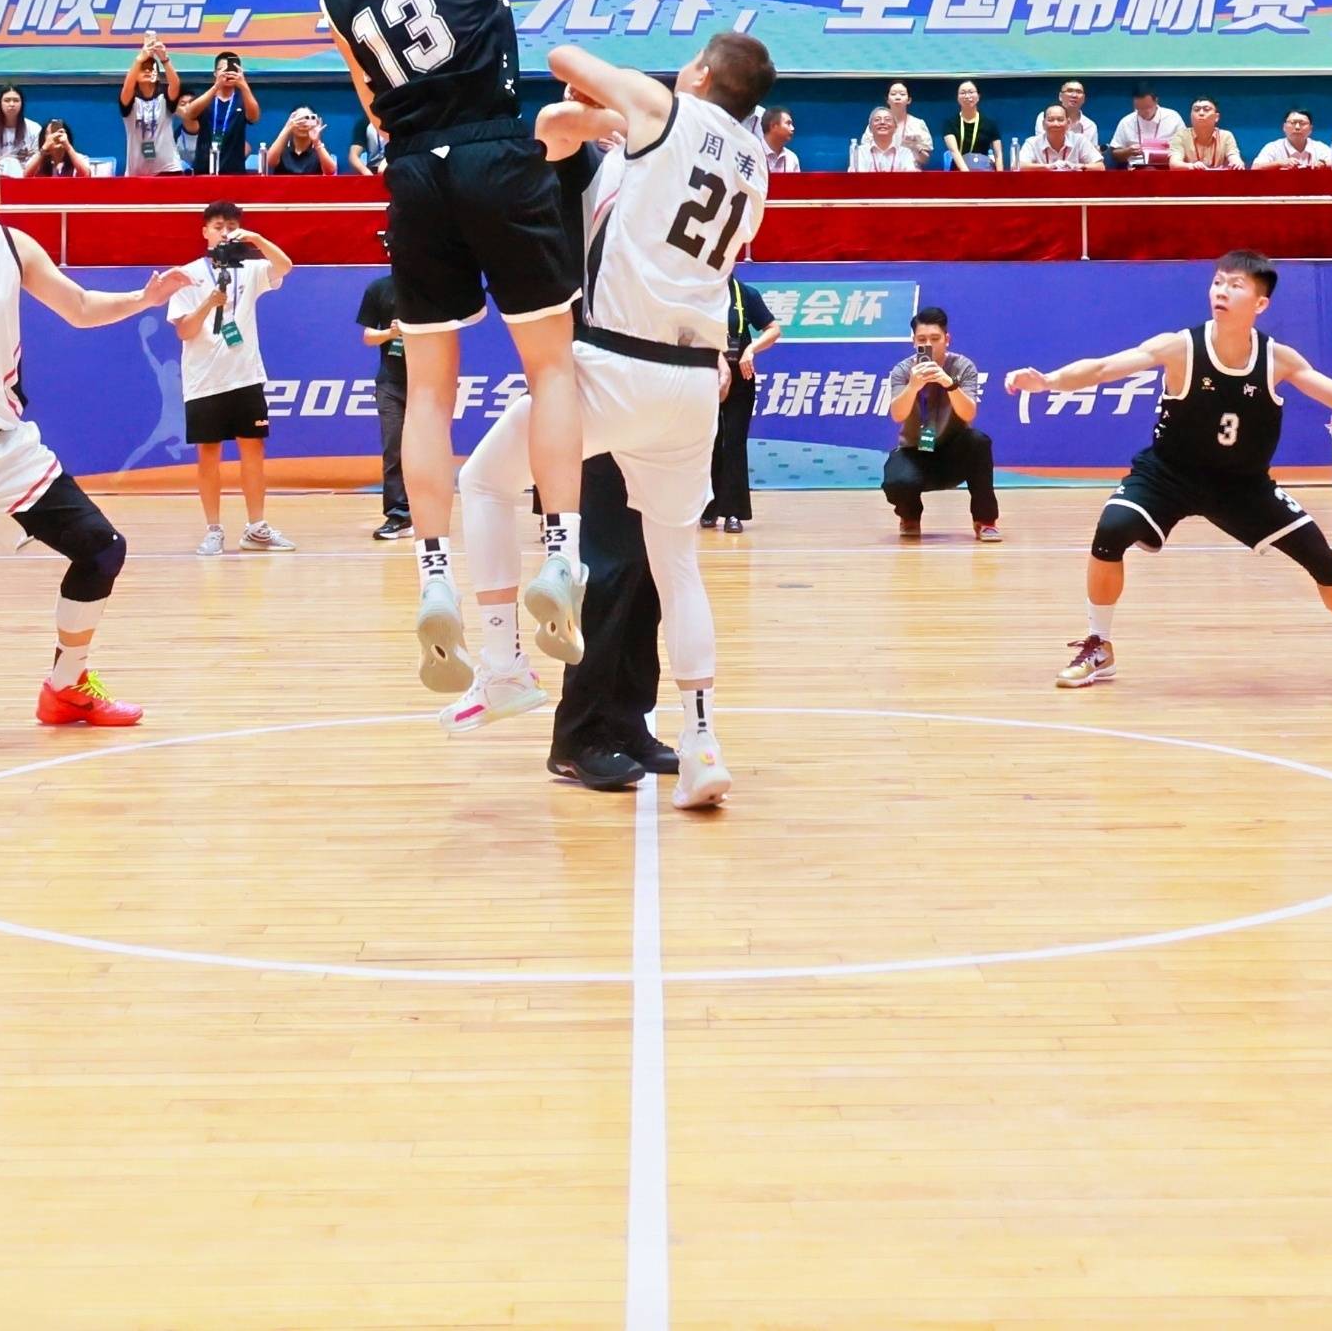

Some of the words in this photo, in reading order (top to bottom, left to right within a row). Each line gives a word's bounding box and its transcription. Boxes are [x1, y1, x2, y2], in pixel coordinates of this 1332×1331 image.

[665, 164, 749, 271] 21
[1217, 412, 1240, 447] 3
[1273, 486, 1304, 514] 3
[421, 553, 448, 568] 33
